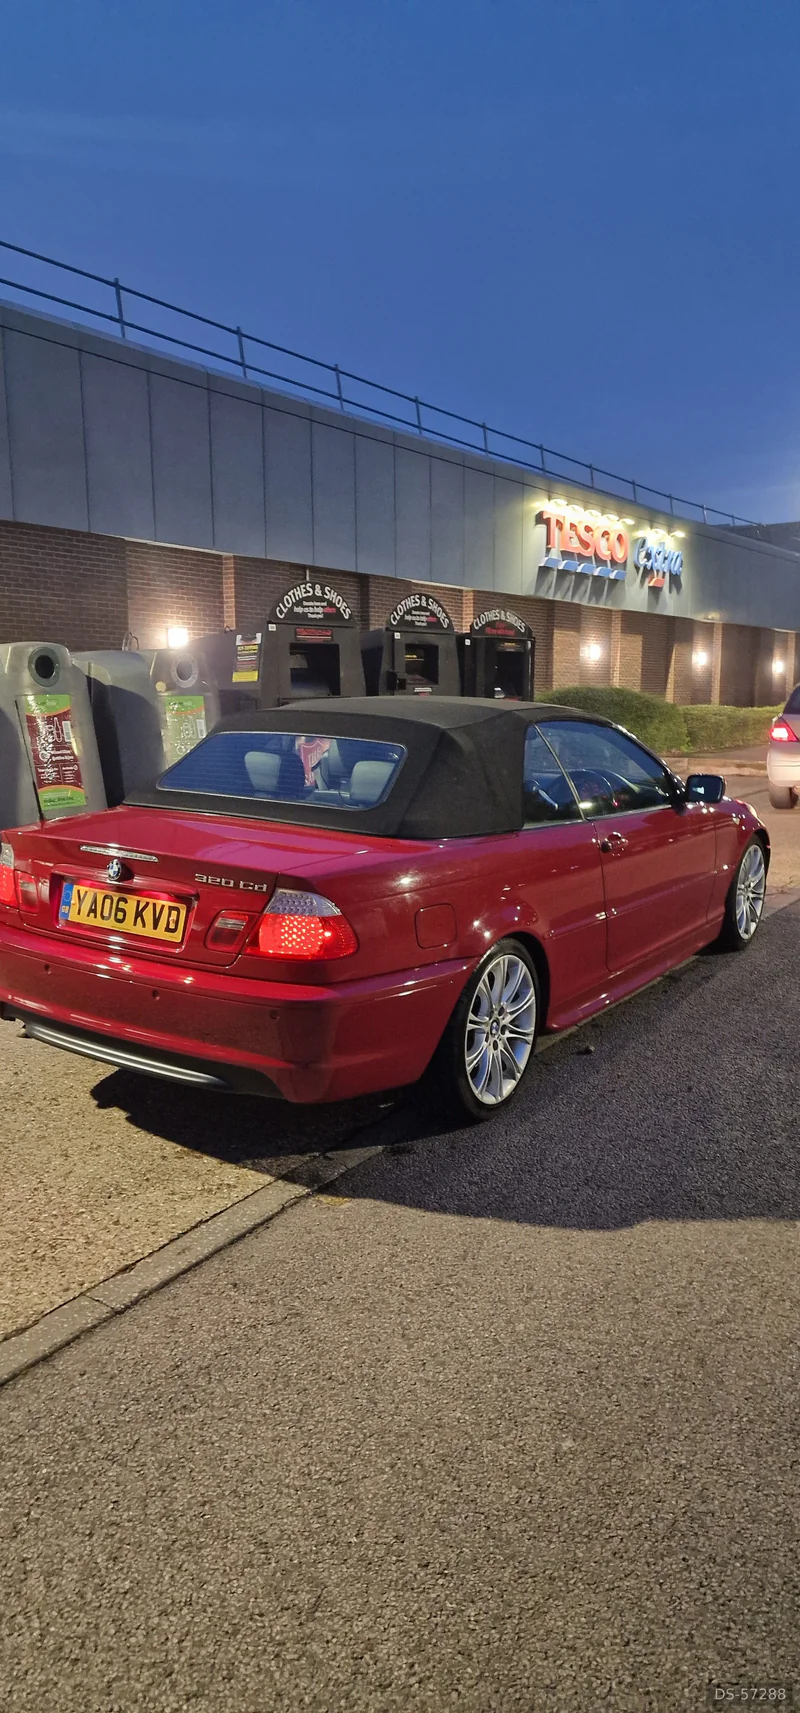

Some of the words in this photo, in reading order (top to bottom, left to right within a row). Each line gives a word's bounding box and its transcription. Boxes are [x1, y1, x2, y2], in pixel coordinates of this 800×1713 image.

[542, 510, 629, 564] TESCO
[276, 583, 313, 619] CLOTHES
[314, 584, 323, 597] &
[323, 586, 352, 620] SHOES
[390, 594, 420, 625] CLOTHES
[421, 595, 428, 607] &
[427, 598, 450, 629] SHOES
[473, 609, 500, 630] CLOTHES
[505, 611, 527, 633] SHOES
[194, 873, 234, 887] 320
[239, 880, 268, 892] Cd
[76, 889, 129, 924] YA06
[132, 899, 181, 934] KVD
